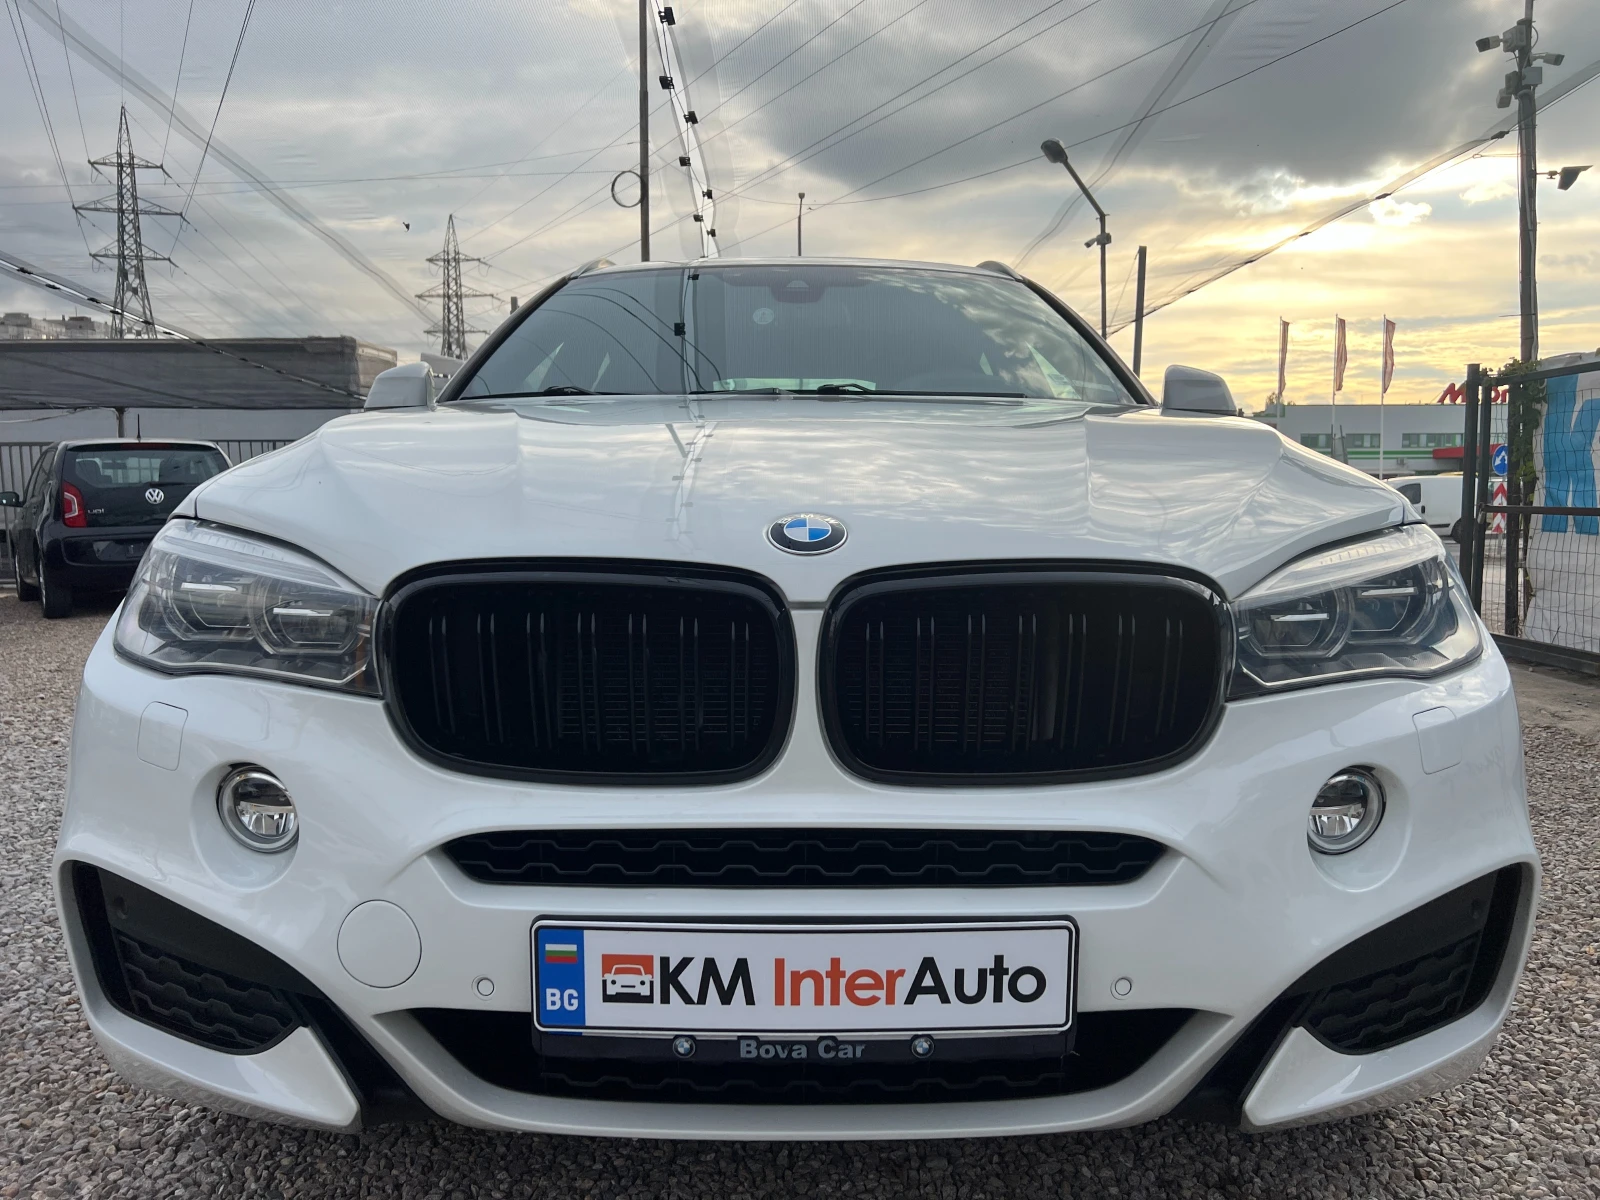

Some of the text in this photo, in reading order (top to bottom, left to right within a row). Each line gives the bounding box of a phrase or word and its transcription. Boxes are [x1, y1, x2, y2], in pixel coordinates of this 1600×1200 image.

[145, 488, 164, 504] VW
[659, 954, 1047, 1007] KM InterAuto
[545, 988, 579, 1011] BG
[739, 1038, 867, 1059] Bova Car
